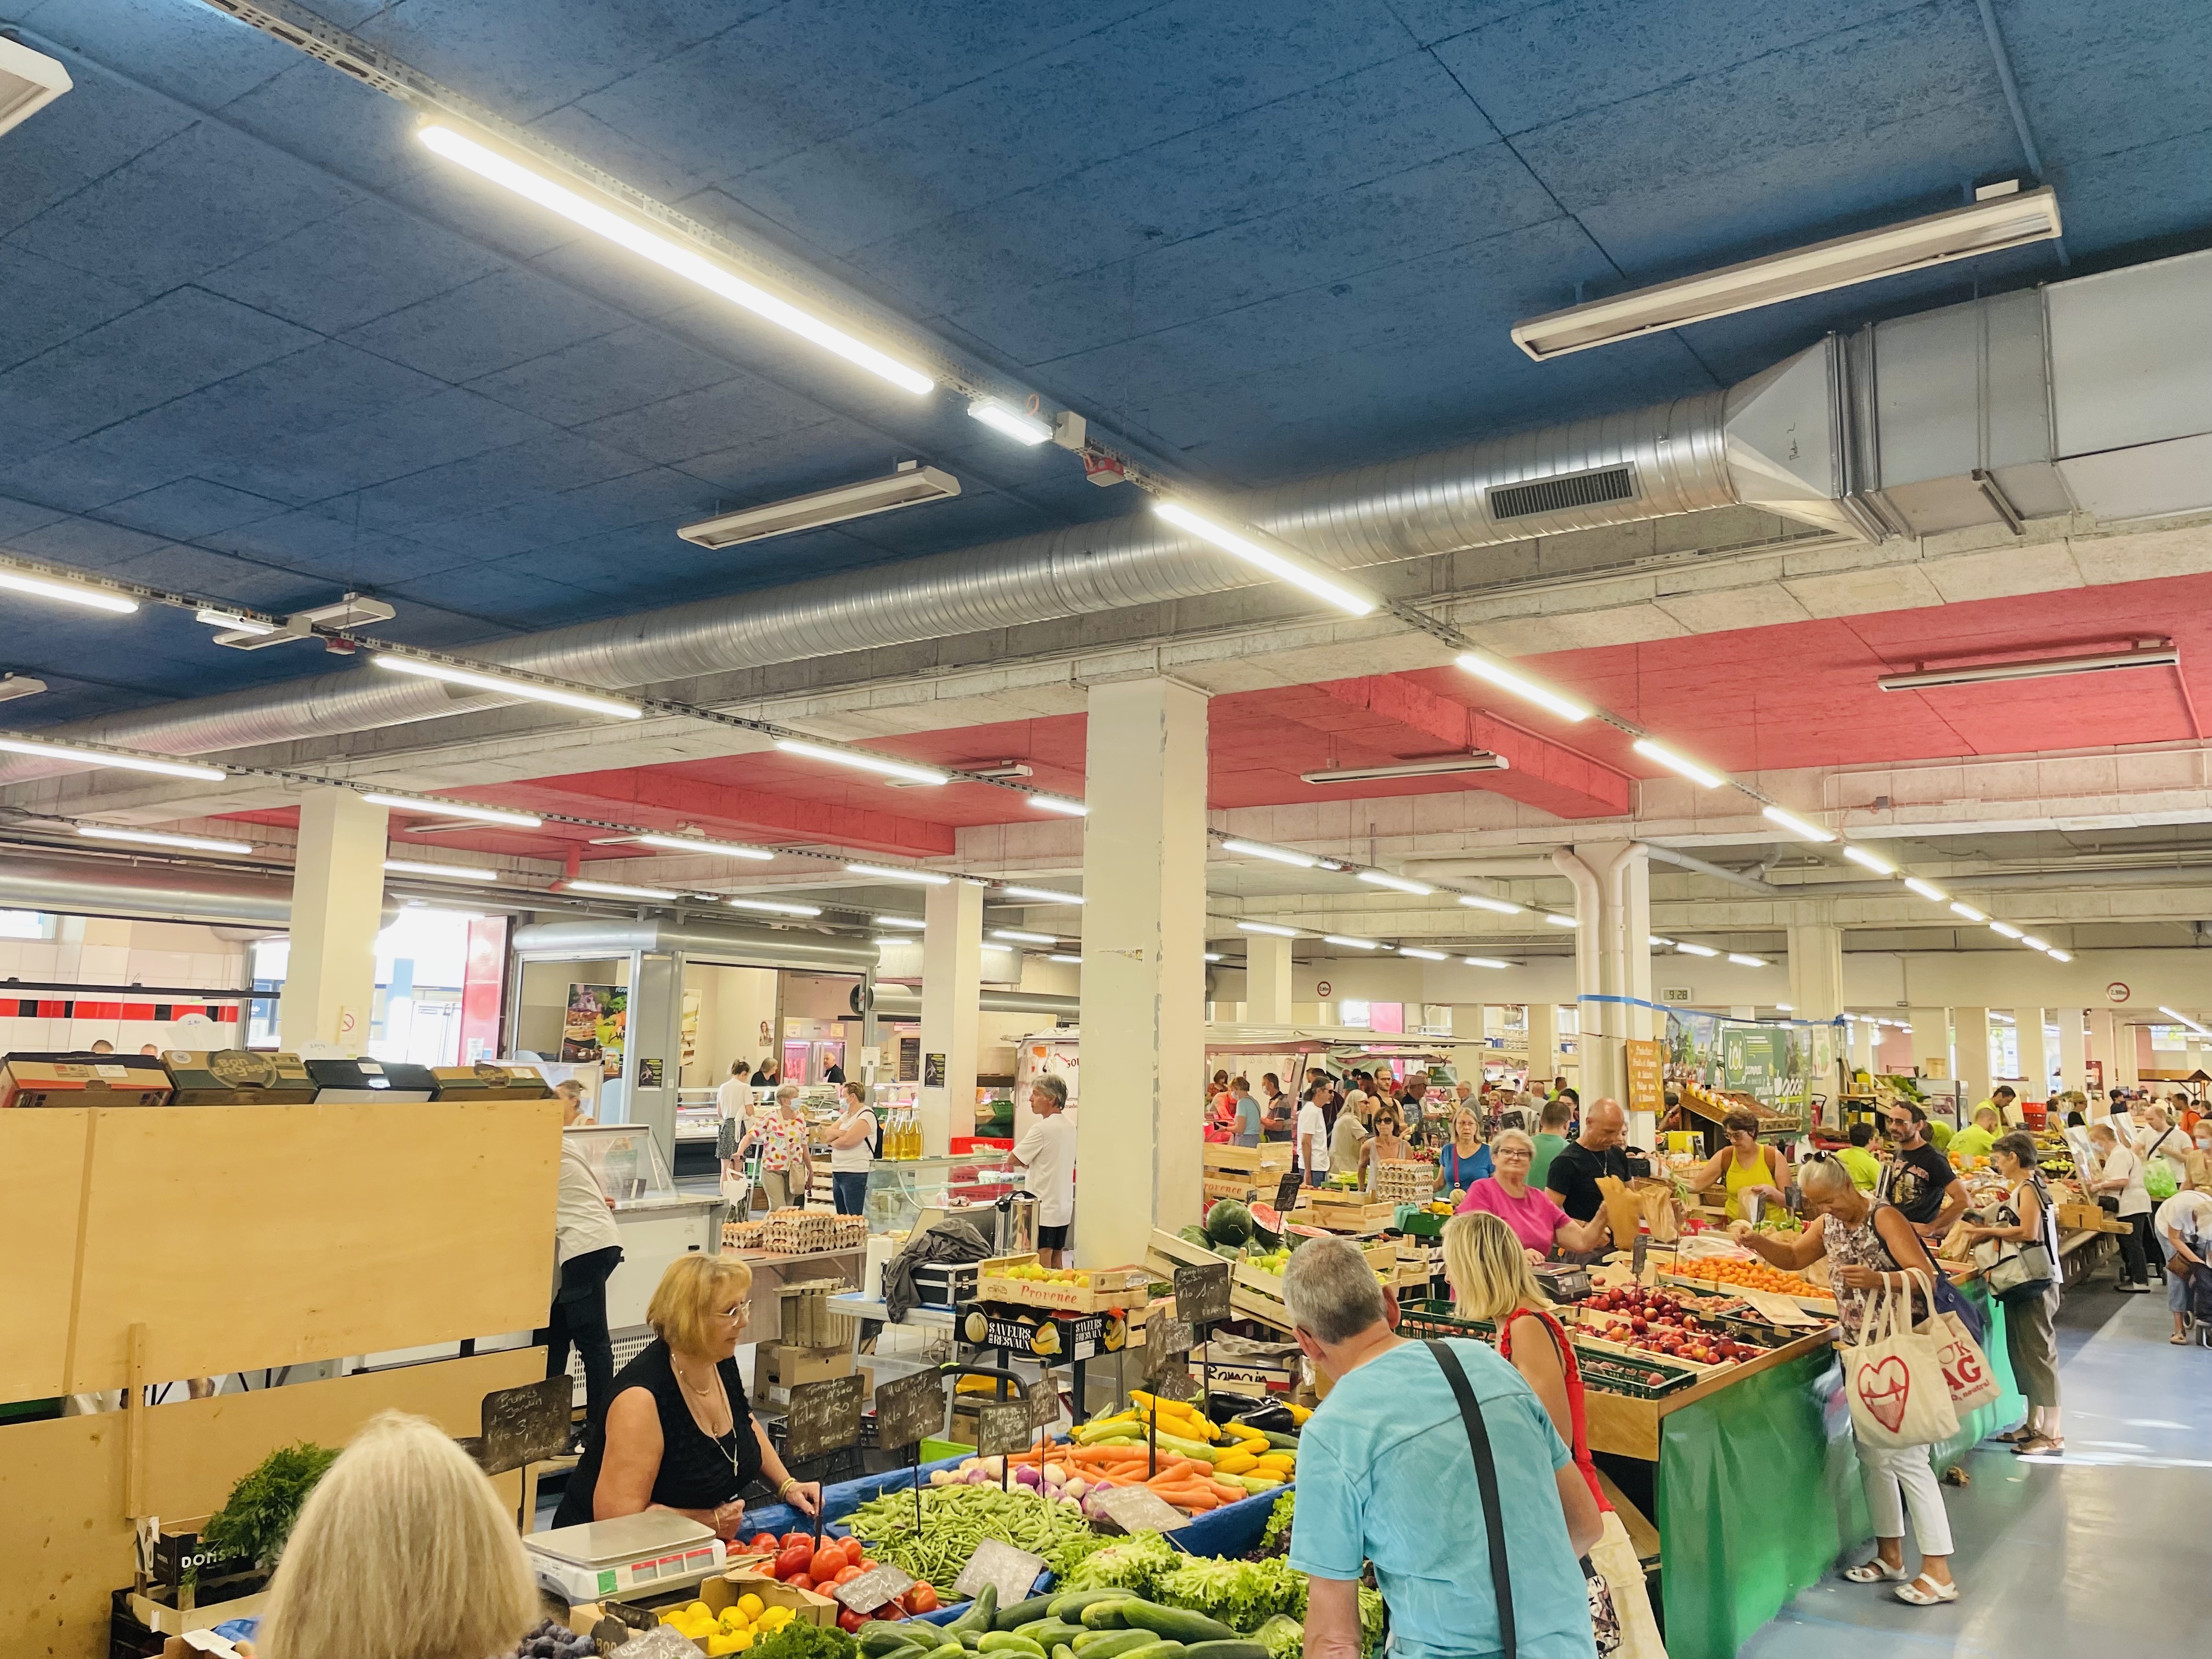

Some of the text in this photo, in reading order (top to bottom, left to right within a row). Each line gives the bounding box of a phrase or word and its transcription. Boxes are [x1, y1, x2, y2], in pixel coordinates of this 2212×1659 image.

[1729, 1040, 1744, 1070] ici
[1204, 1182, 1243, 1195] rovence
[1020, 1284, 1077, 1305] Provence
[989, 1322, 1031, 1340] SAVEURS
